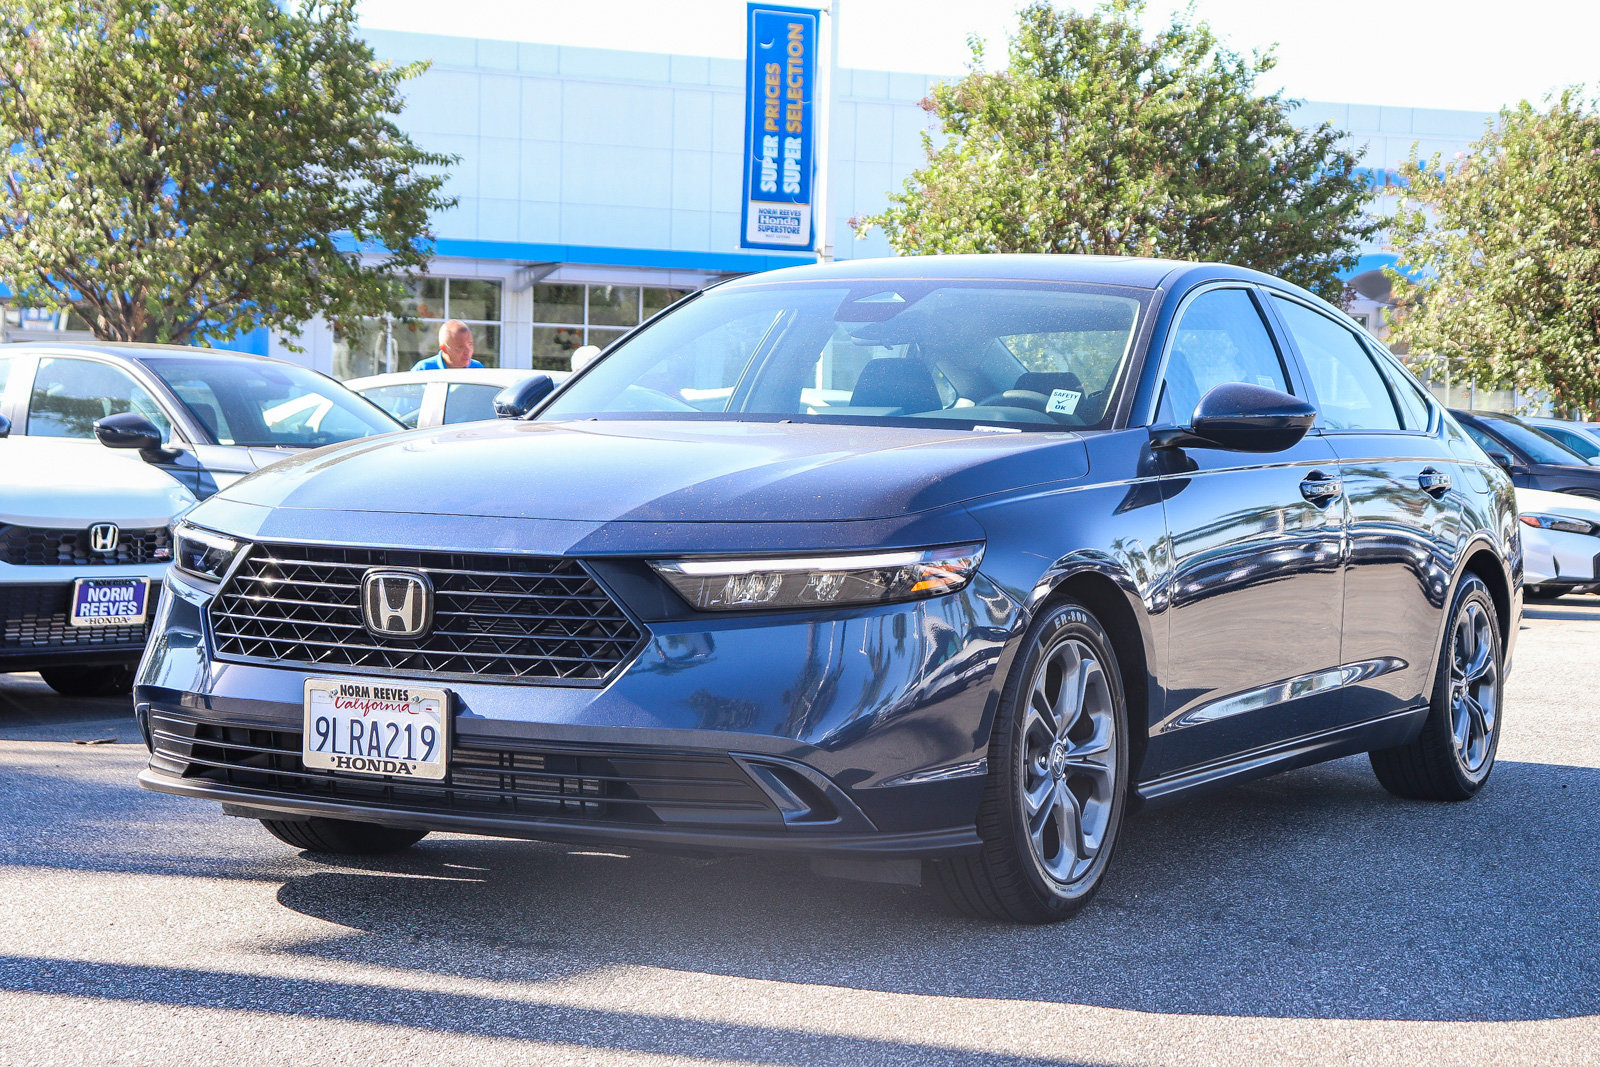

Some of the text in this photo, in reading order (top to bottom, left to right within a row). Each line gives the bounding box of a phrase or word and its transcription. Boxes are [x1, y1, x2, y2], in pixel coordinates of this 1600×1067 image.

[783, 23, 803, 194] SUPER SELECTION
[760, 62, 781, 193] SUPER PRICES
[760, 215, 800, 226] Honda
[758, 225, 801, 234] SUPERSTORE
[88, 587, 134, 602] NORM
[80, 602, 137, 616] REEVES
[89, 617, 127, 625] HONDA
[340, 685, 409, 701] NORM REEVES
[335, 697, 419, 717] California
[316, 716, 435, 762] 9LRA219
[336, 756, 412, 775] HONDA
